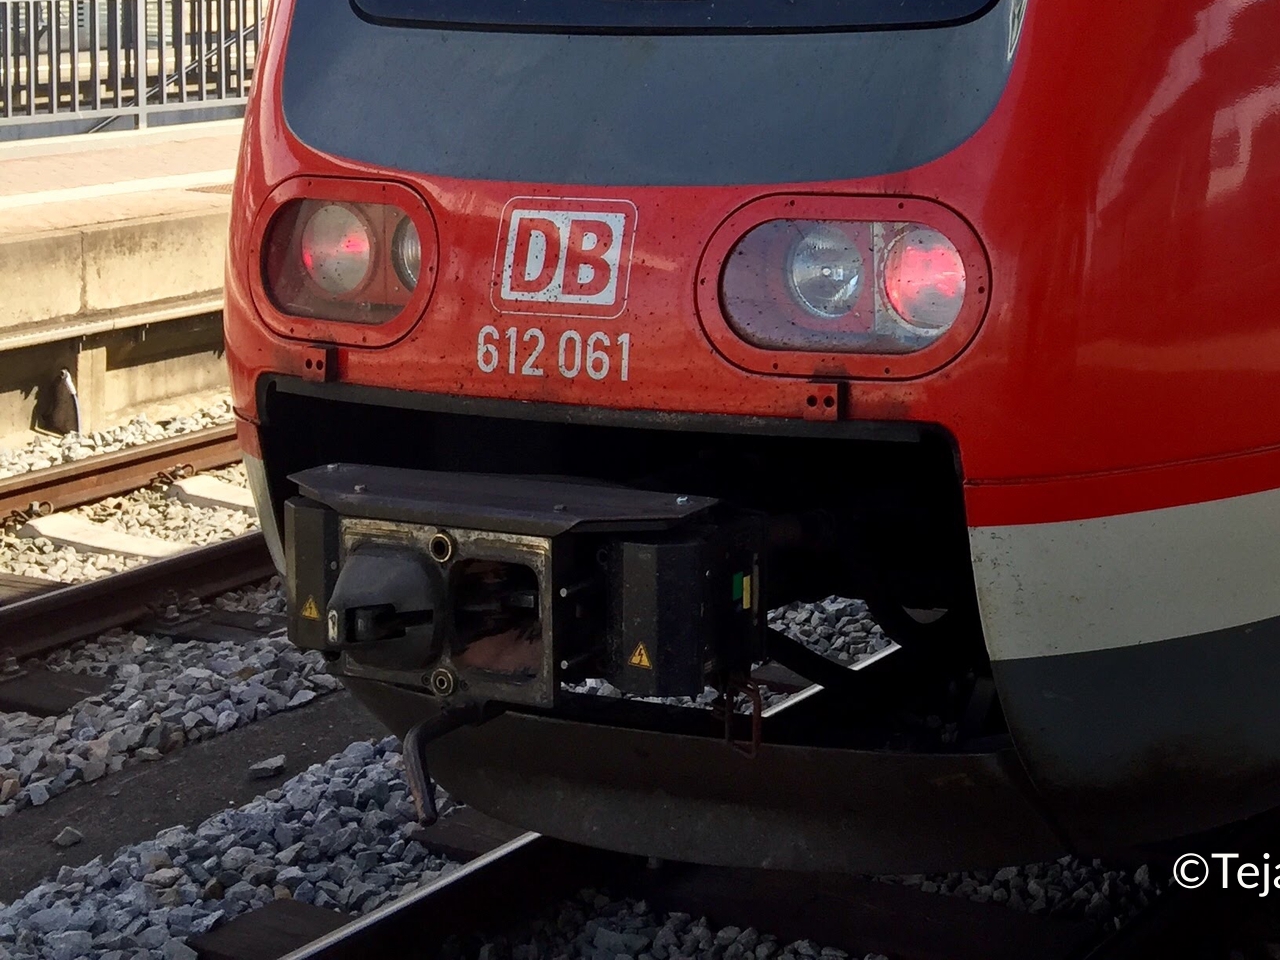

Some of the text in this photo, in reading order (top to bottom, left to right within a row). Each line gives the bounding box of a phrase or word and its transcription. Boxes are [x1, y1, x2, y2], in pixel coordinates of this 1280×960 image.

[501, 209, 625, 305] DB
[477, 325, 630, 381] 612 061
